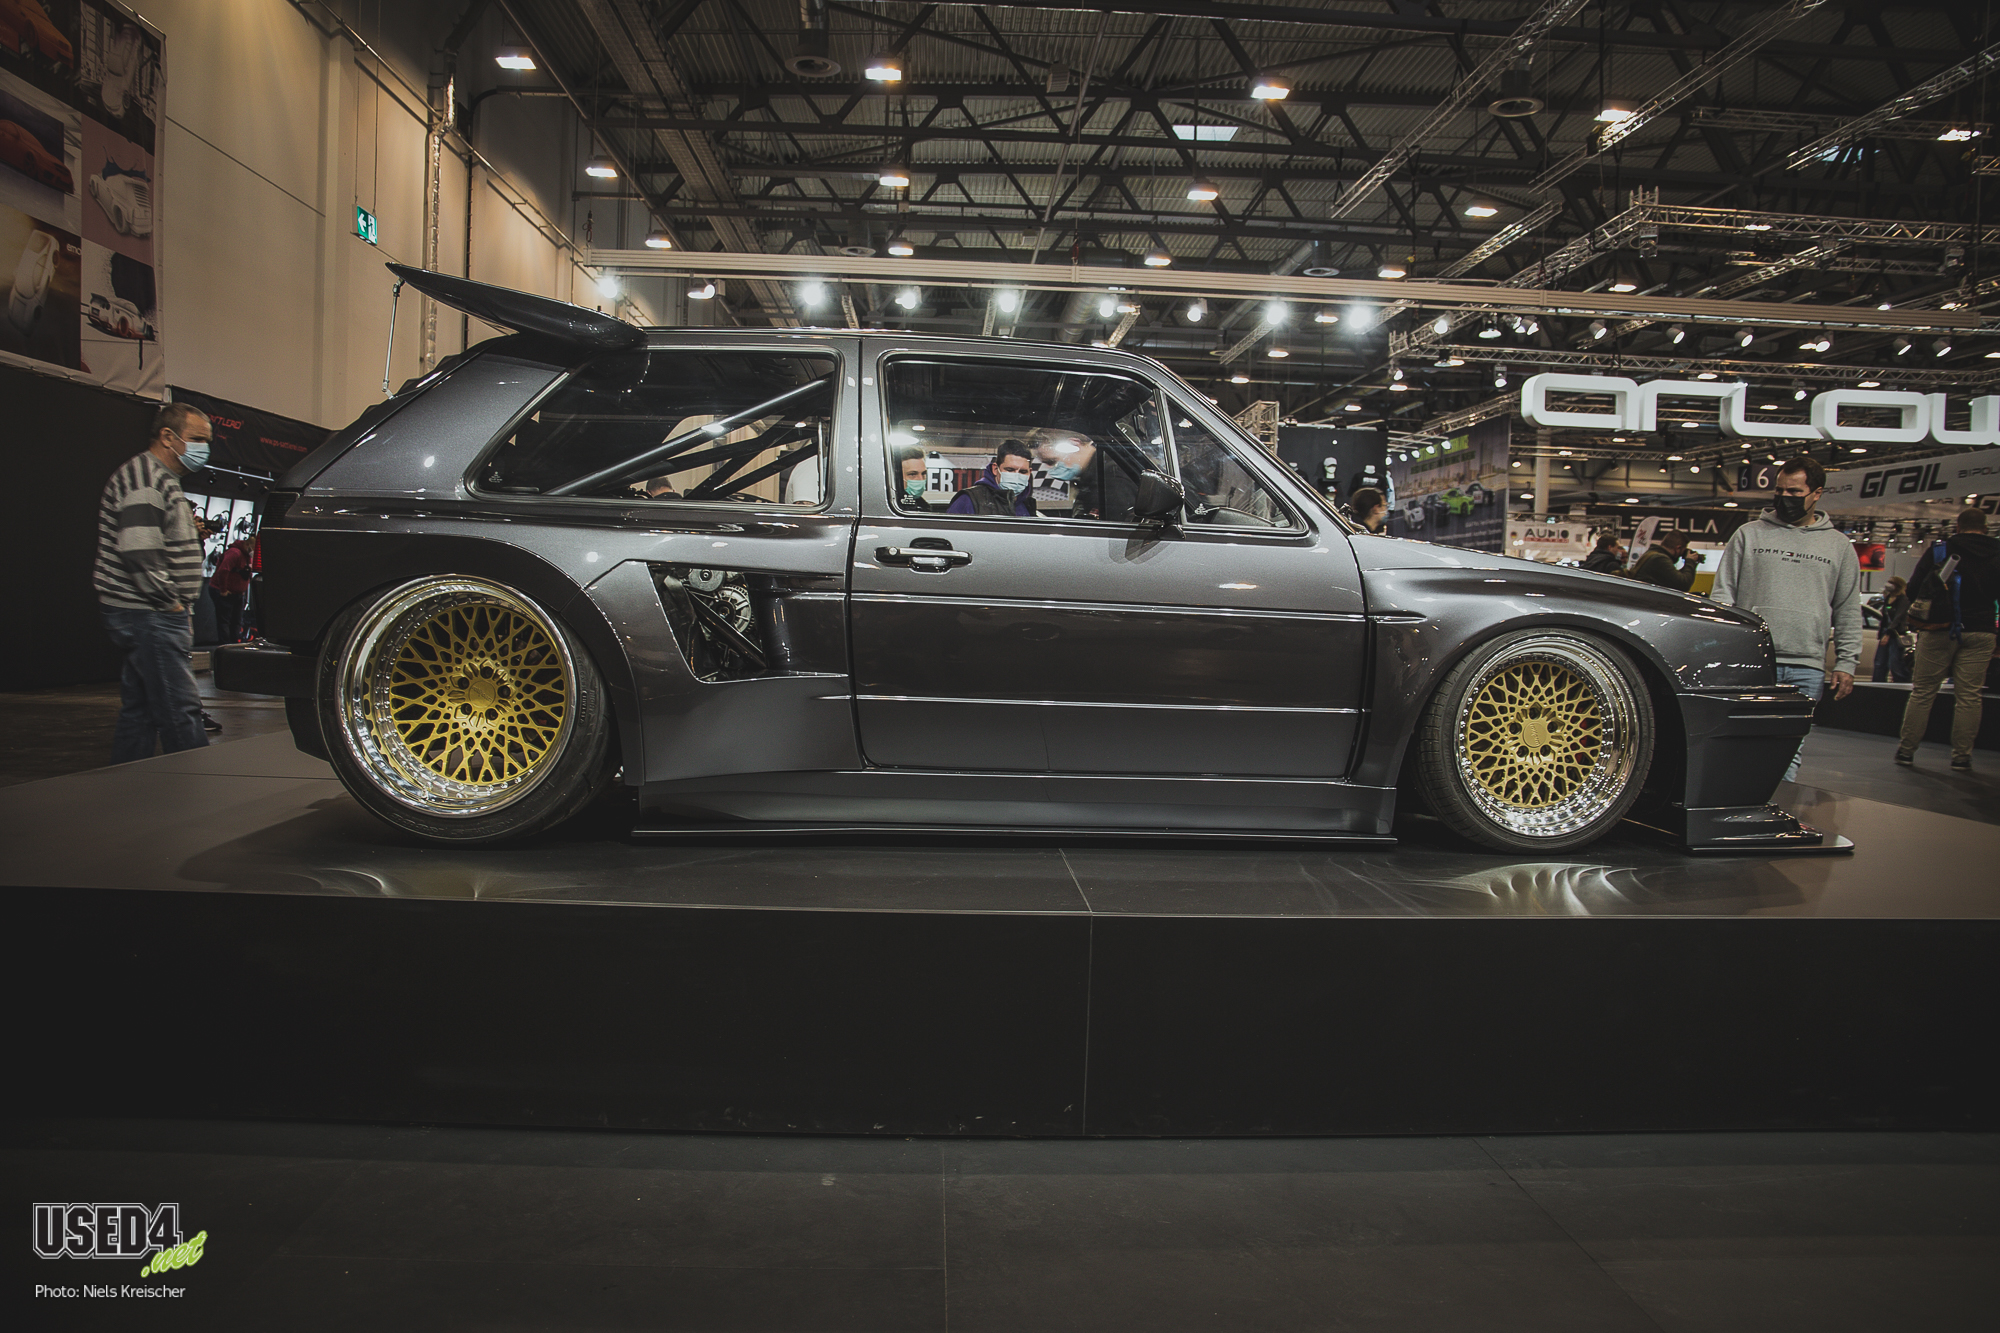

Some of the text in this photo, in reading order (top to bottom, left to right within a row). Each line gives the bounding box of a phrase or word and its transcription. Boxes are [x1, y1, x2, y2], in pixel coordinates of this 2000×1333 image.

[1756, 467, 1769, 489] 6
[1958, 466, 2000, 479] BIPOL
[1615, 516, 1719, 535] LEELLA
[1752, 548, 1832, 566] TOMMY HILFIGER
